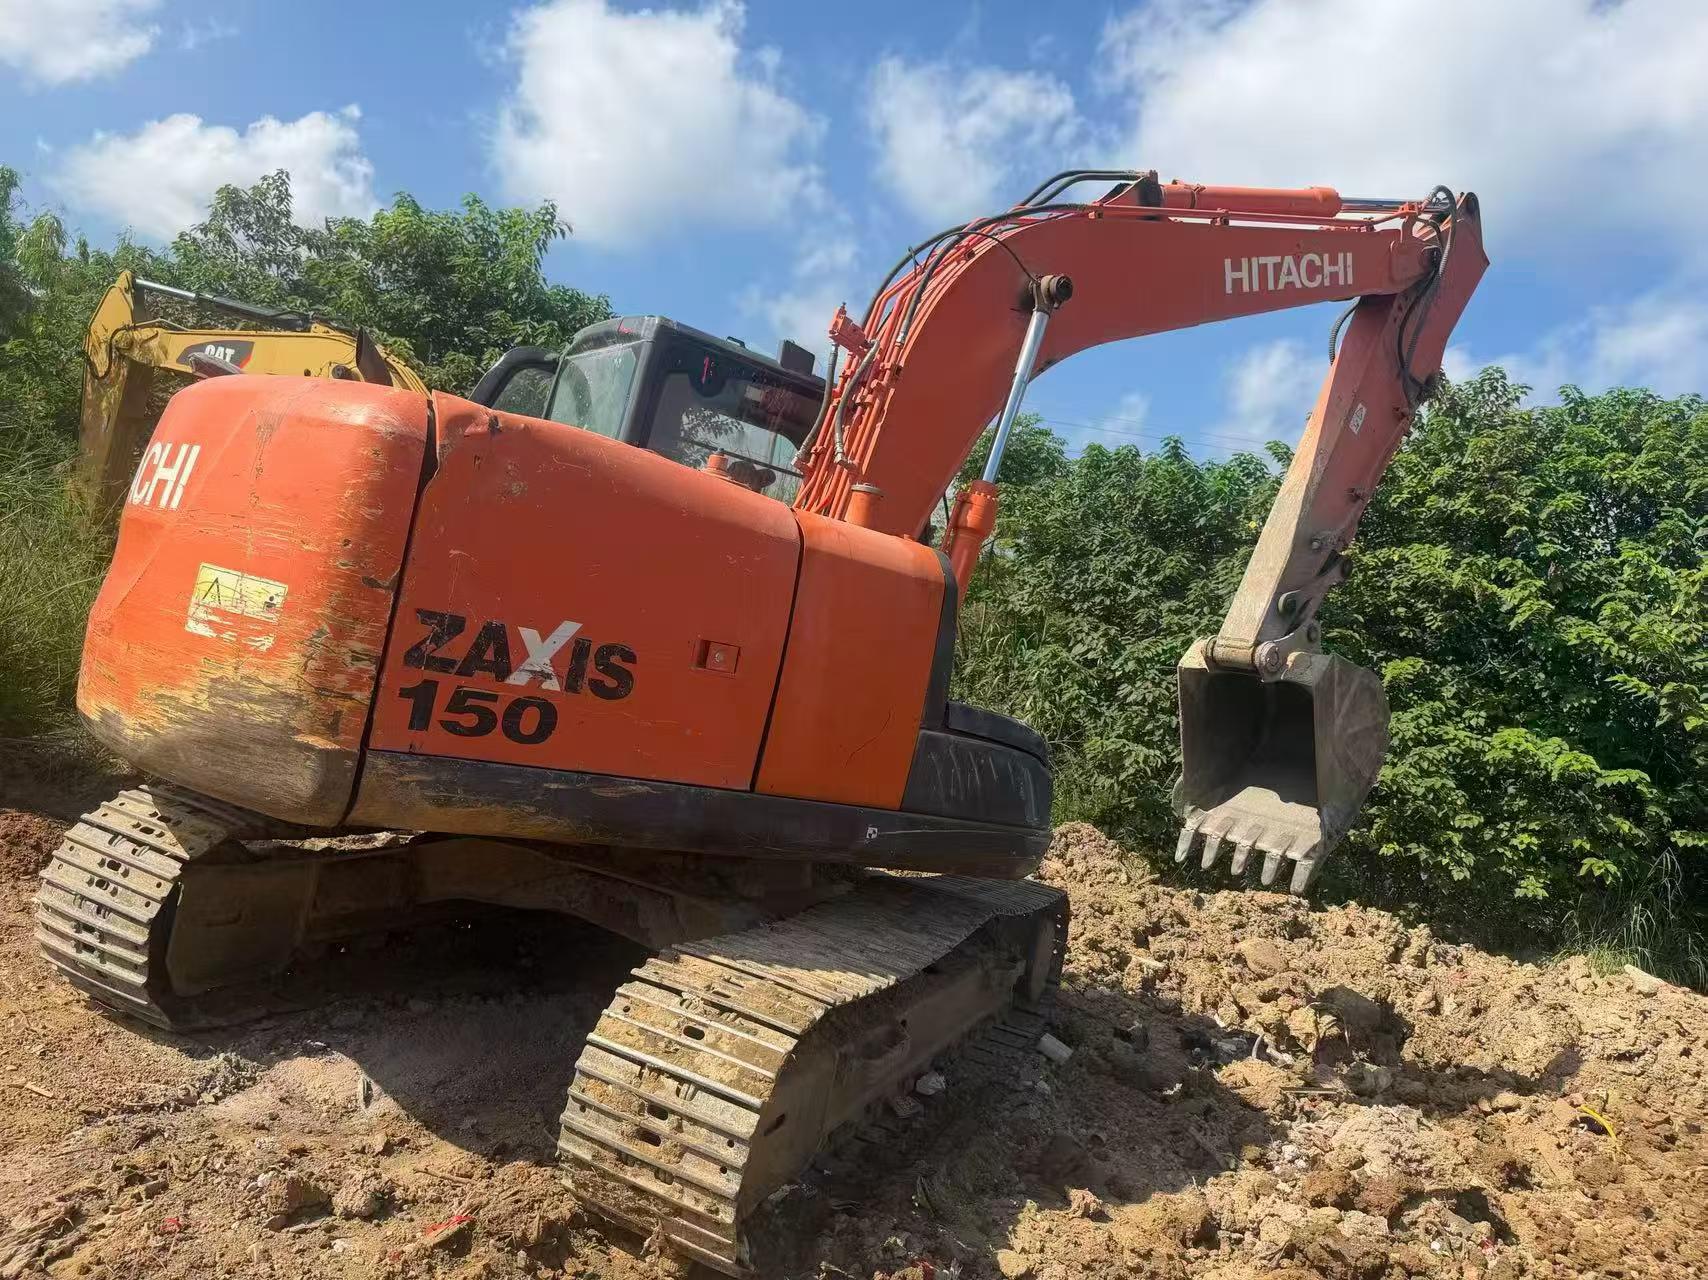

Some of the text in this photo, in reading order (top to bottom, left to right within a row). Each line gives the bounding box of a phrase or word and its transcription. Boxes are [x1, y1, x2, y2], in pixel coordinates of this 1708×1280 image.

[1224, 252, 1353, 295] HITACHI
[127, 441, 201, 511] CHI
[403, 608, 638, 700] ZAXIS
[398, 678, 558, 744] 150
